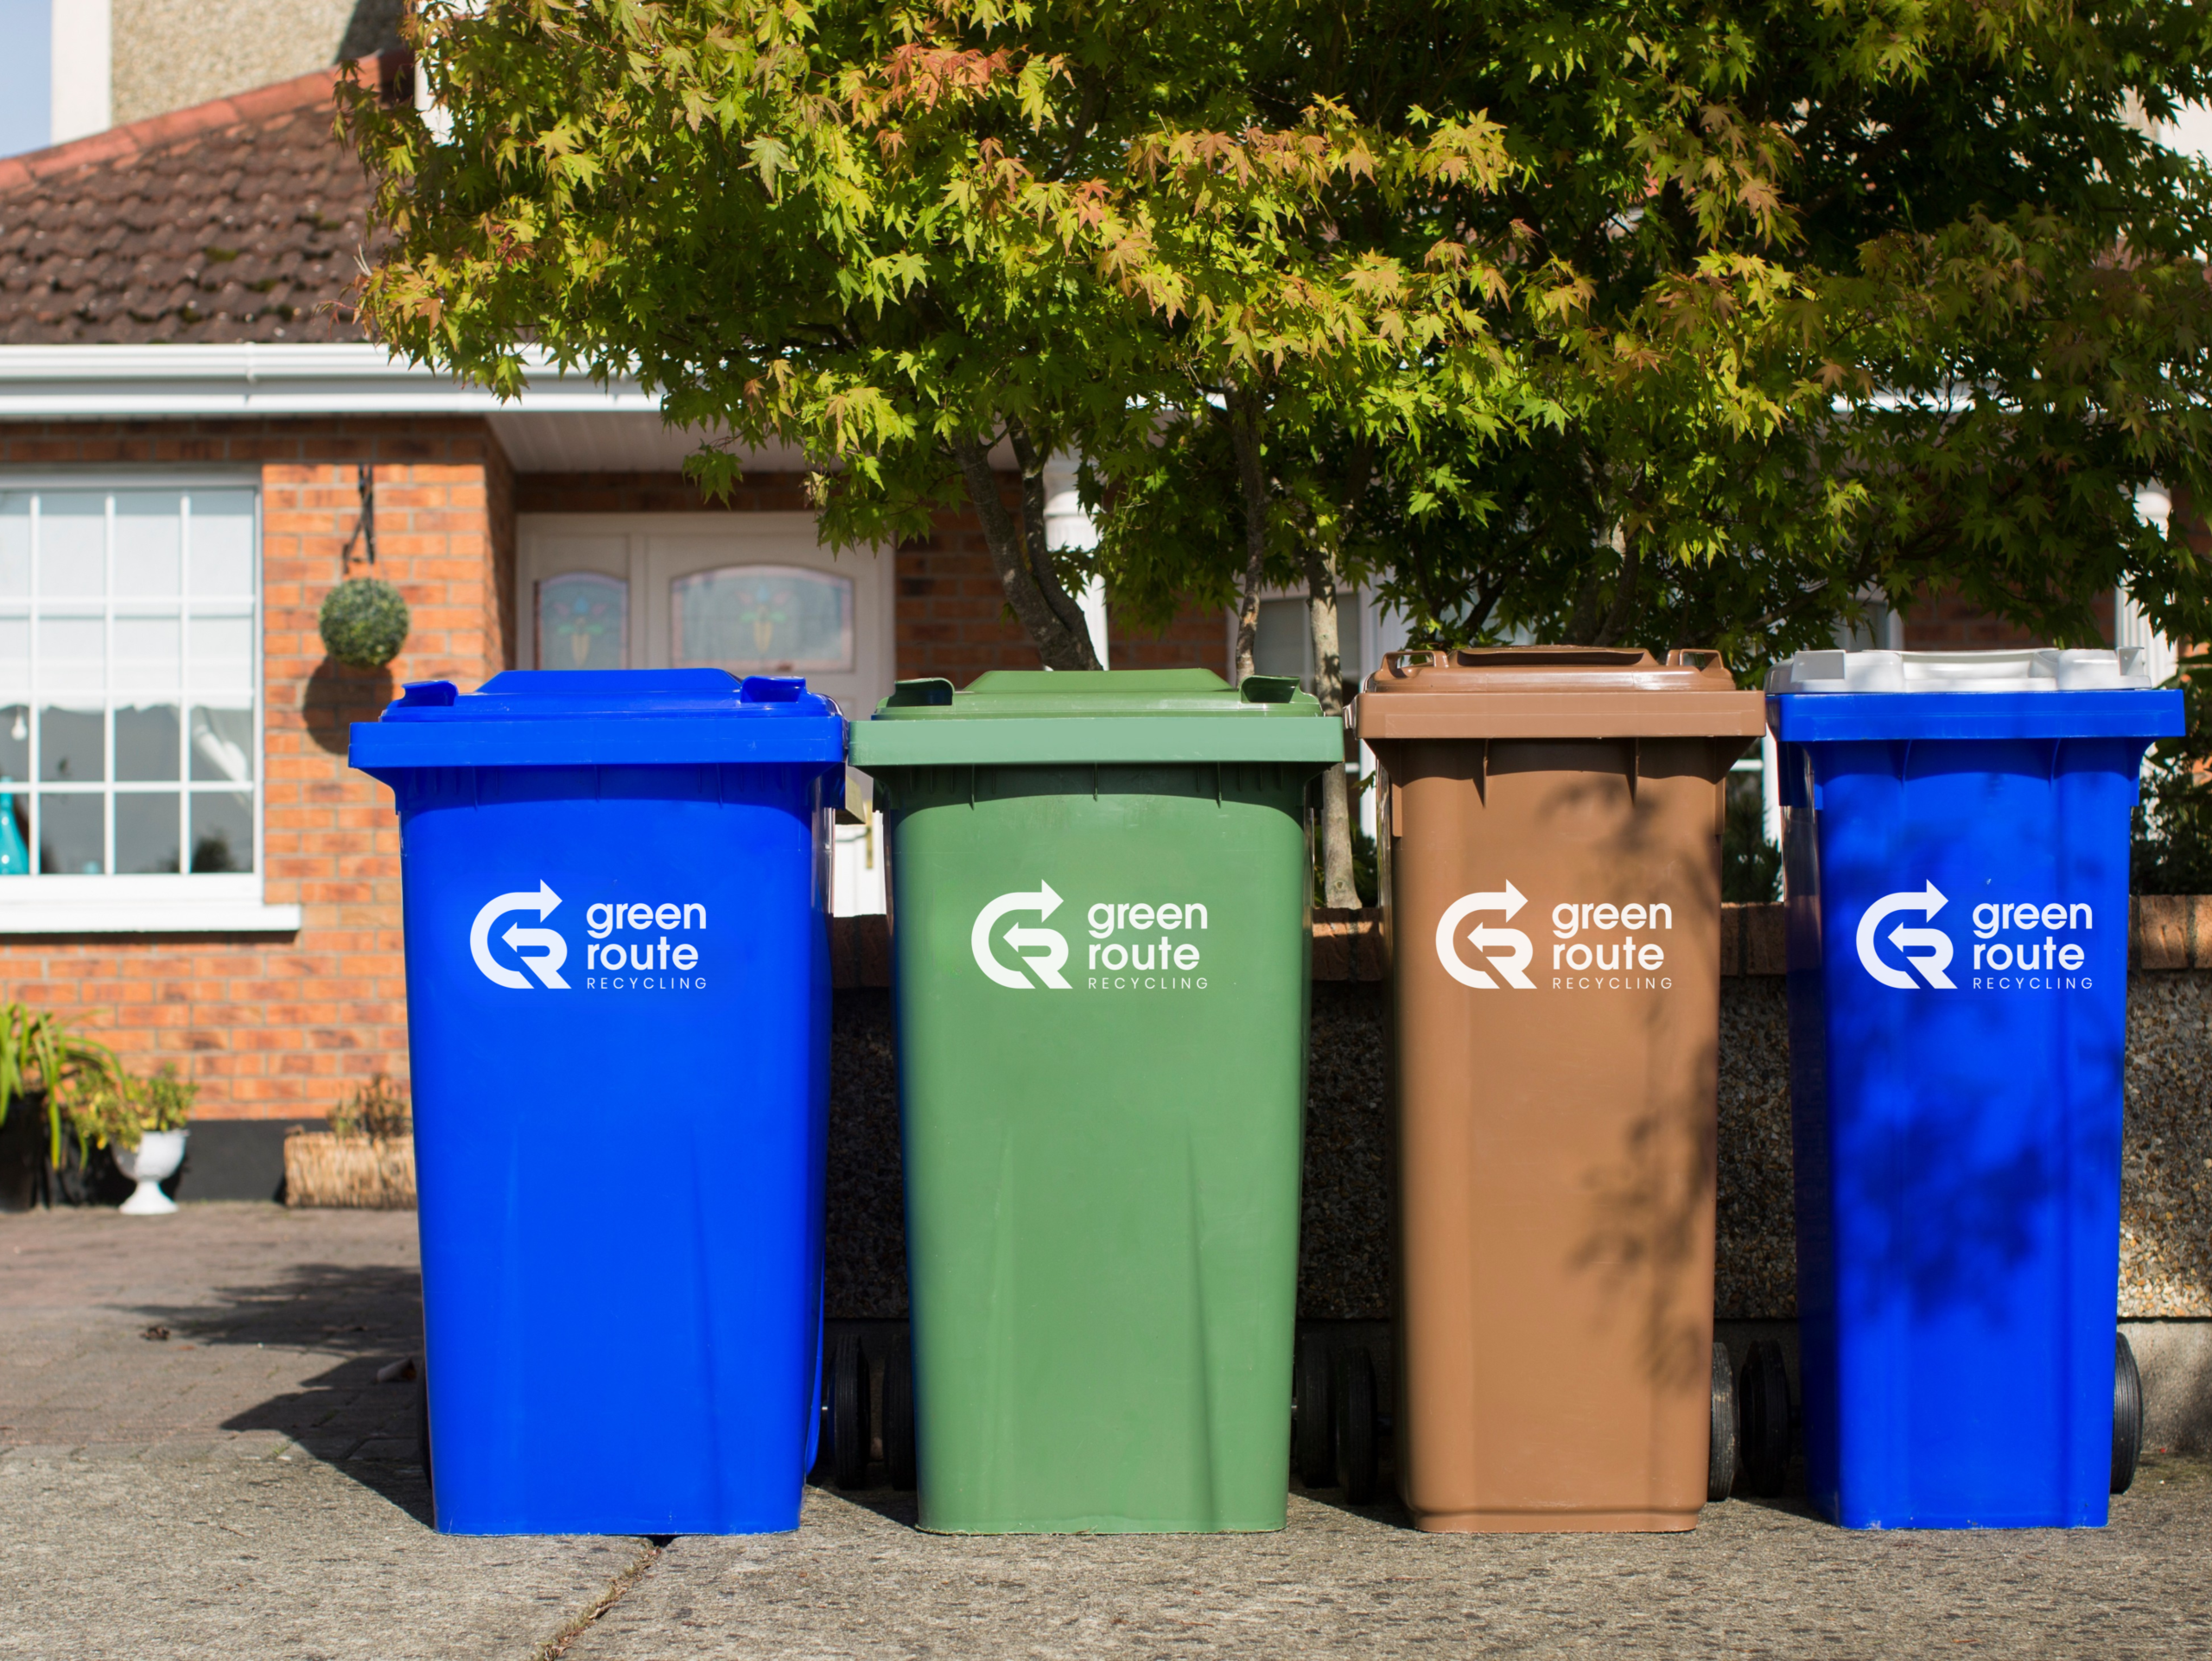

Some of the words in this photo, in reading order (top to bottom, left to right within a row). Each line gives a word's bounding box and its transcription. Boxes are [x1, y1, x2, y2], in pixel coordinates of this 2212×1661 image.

[586, 903, 707, 939] green
[1087, 903, 1208, 939] green
[1552, 903, 1672, 939] green
[1972, 903, 2093, 939] green
[588, 937, 699, 971] route
[1089, 937, 1200, 971] route
[1553, 937, 1664, 971] route
[1974, 937, 2085, 971] route
[587, 977, 707, 990] RECYCLING
[1089, 977, 1208, 990] RECYCLING
[1553, 977, 1672, 990] RECYCLING
[1974, 977, 2093, 990] RECYCLING
